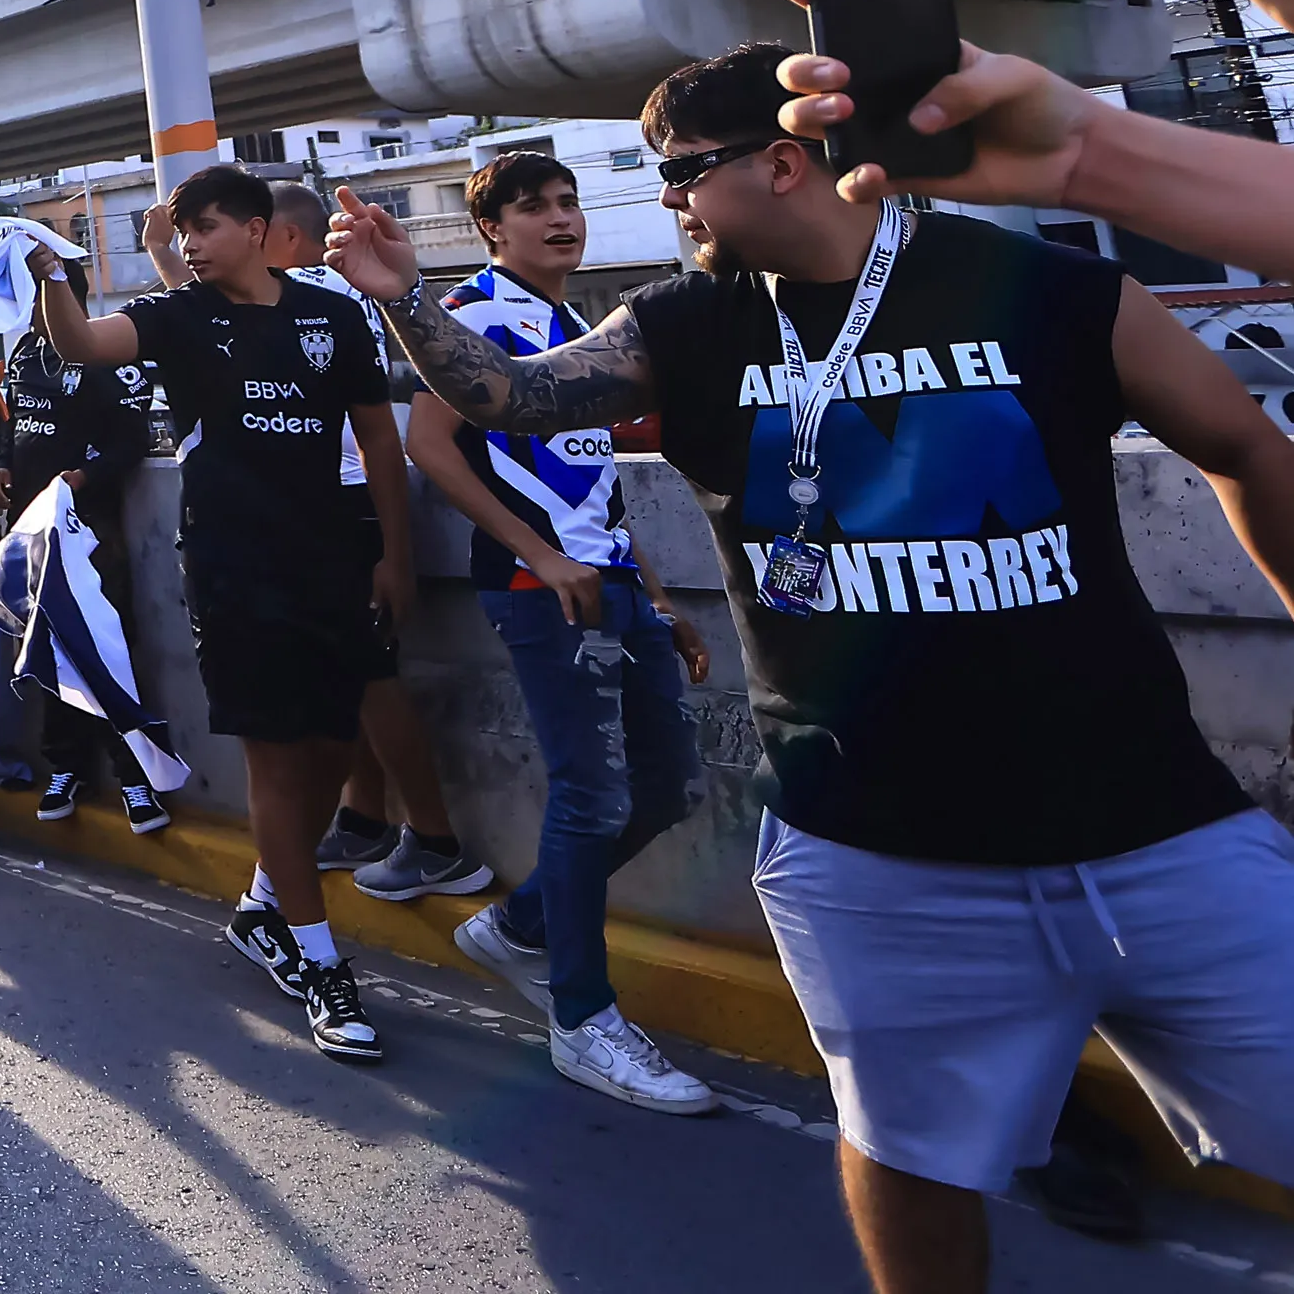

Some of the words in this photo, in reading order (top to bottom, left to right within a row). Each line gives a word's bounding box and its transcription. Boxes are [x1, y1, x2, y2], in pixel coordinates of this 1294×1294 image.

[864, 243, 893, 290] TECATE
[847, 297, 874, 336] BBVA
[822, 341, 853, 389] codere
[949, 340, 1022, 386] EL
[16, 393, 52, 410] BBVA
[244, 380, 305, 400] BBVA
[242, 411, 324, 434] codere
